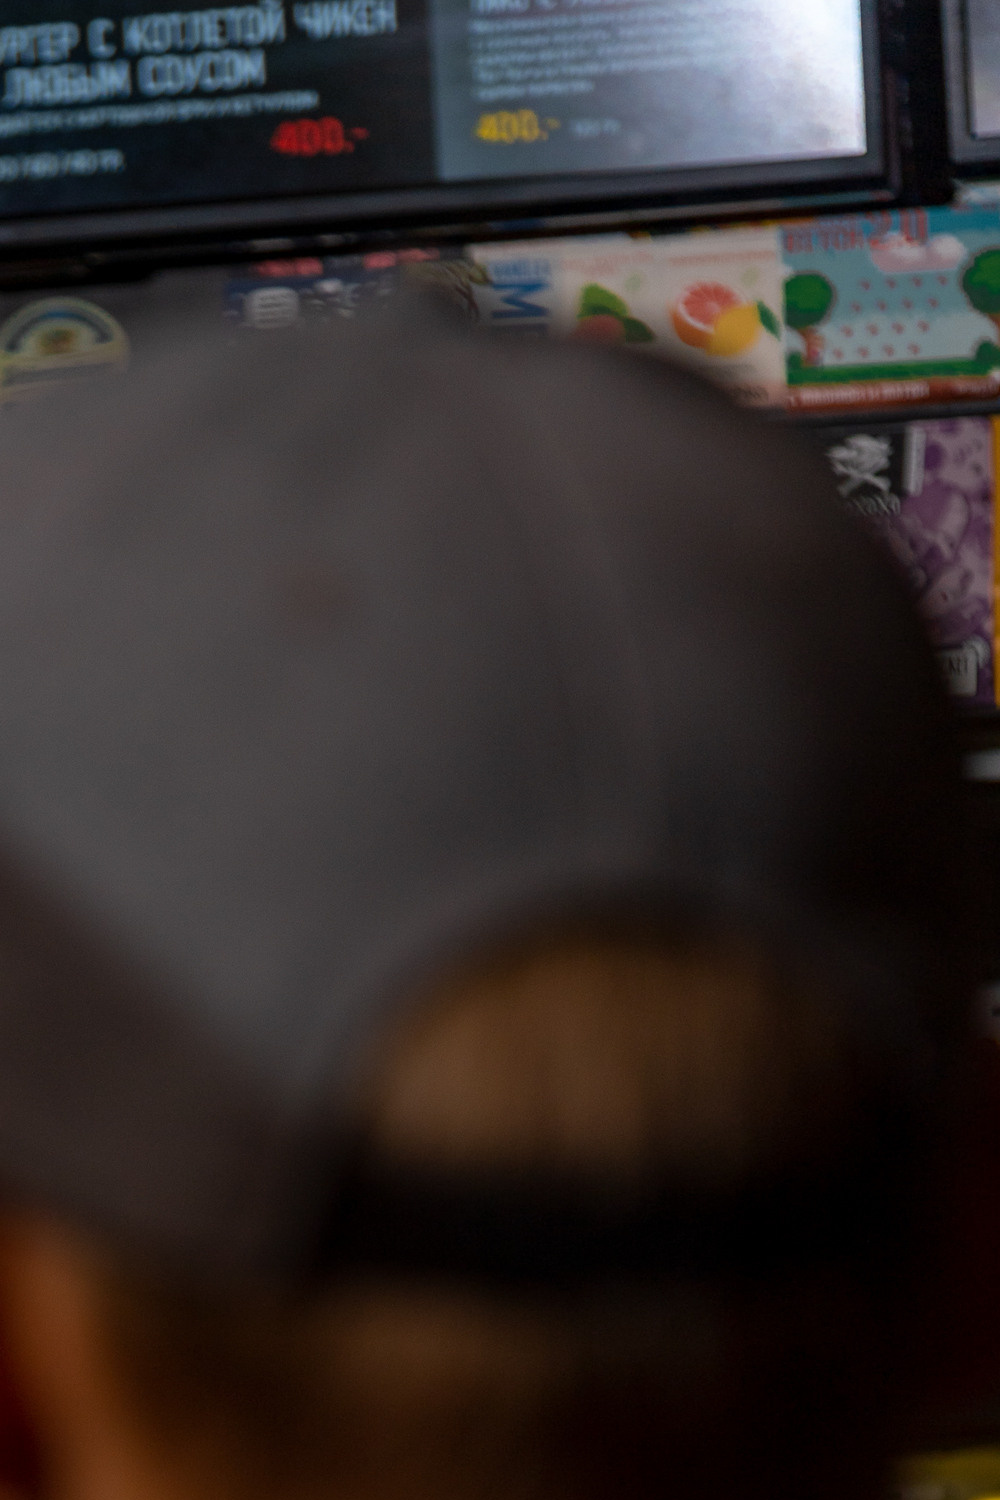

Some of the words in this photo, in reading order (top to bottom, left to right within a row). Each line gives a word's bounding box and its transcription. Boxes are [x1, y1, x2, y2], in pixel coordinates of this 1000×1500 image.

[86, 17, 117, 60] С
[122, 0, 287, 54] КОТЛЕТОЙ
[3, 60, 132, 107] ЛЮБЫМ
[138, 49, 267, 96] СОУСОМ
